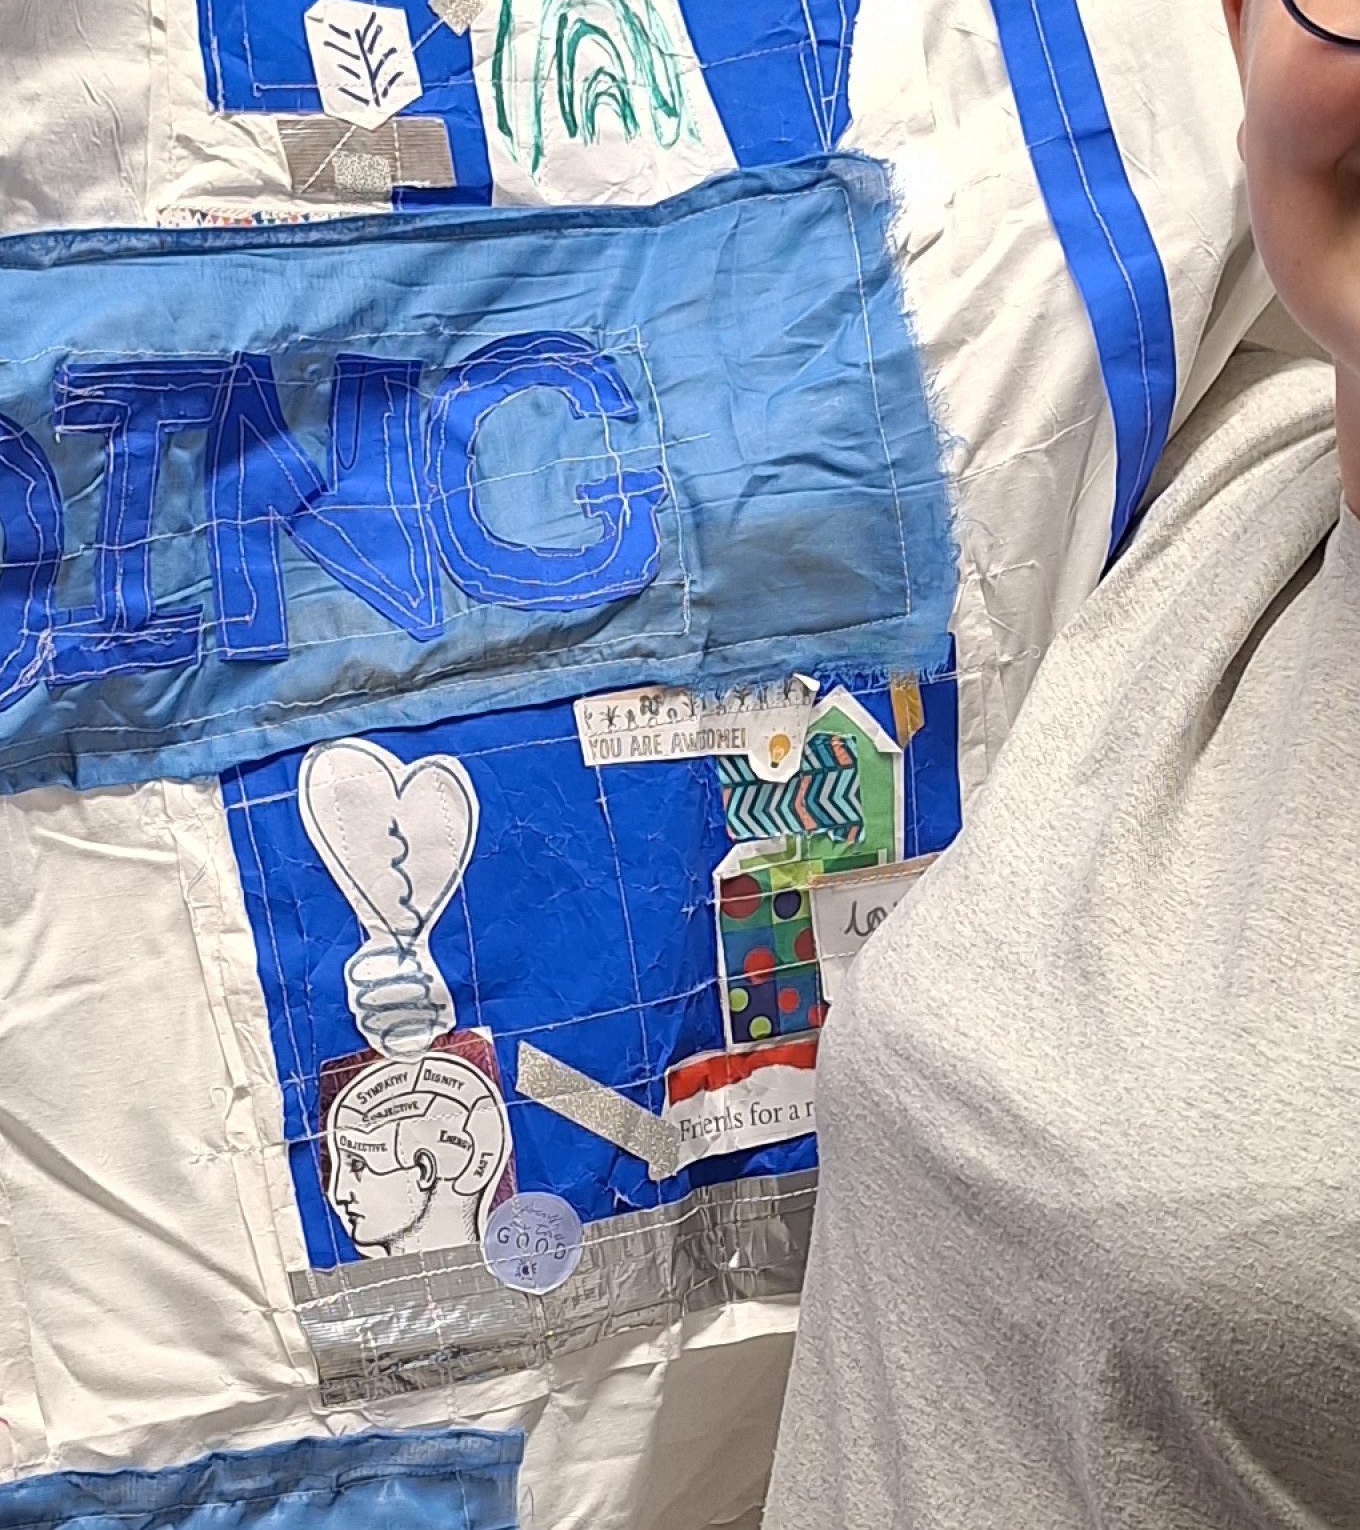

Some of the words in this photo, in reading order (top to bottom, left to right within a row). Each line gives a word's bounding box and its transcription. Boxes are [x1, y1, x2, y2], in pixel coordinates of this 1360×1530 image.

[588, 737, 622, 759] YOU
[630, 734, 663, 757] ARE
[750, 1101, 783, 1126] for
[788, 1103, 801, 1121] a
